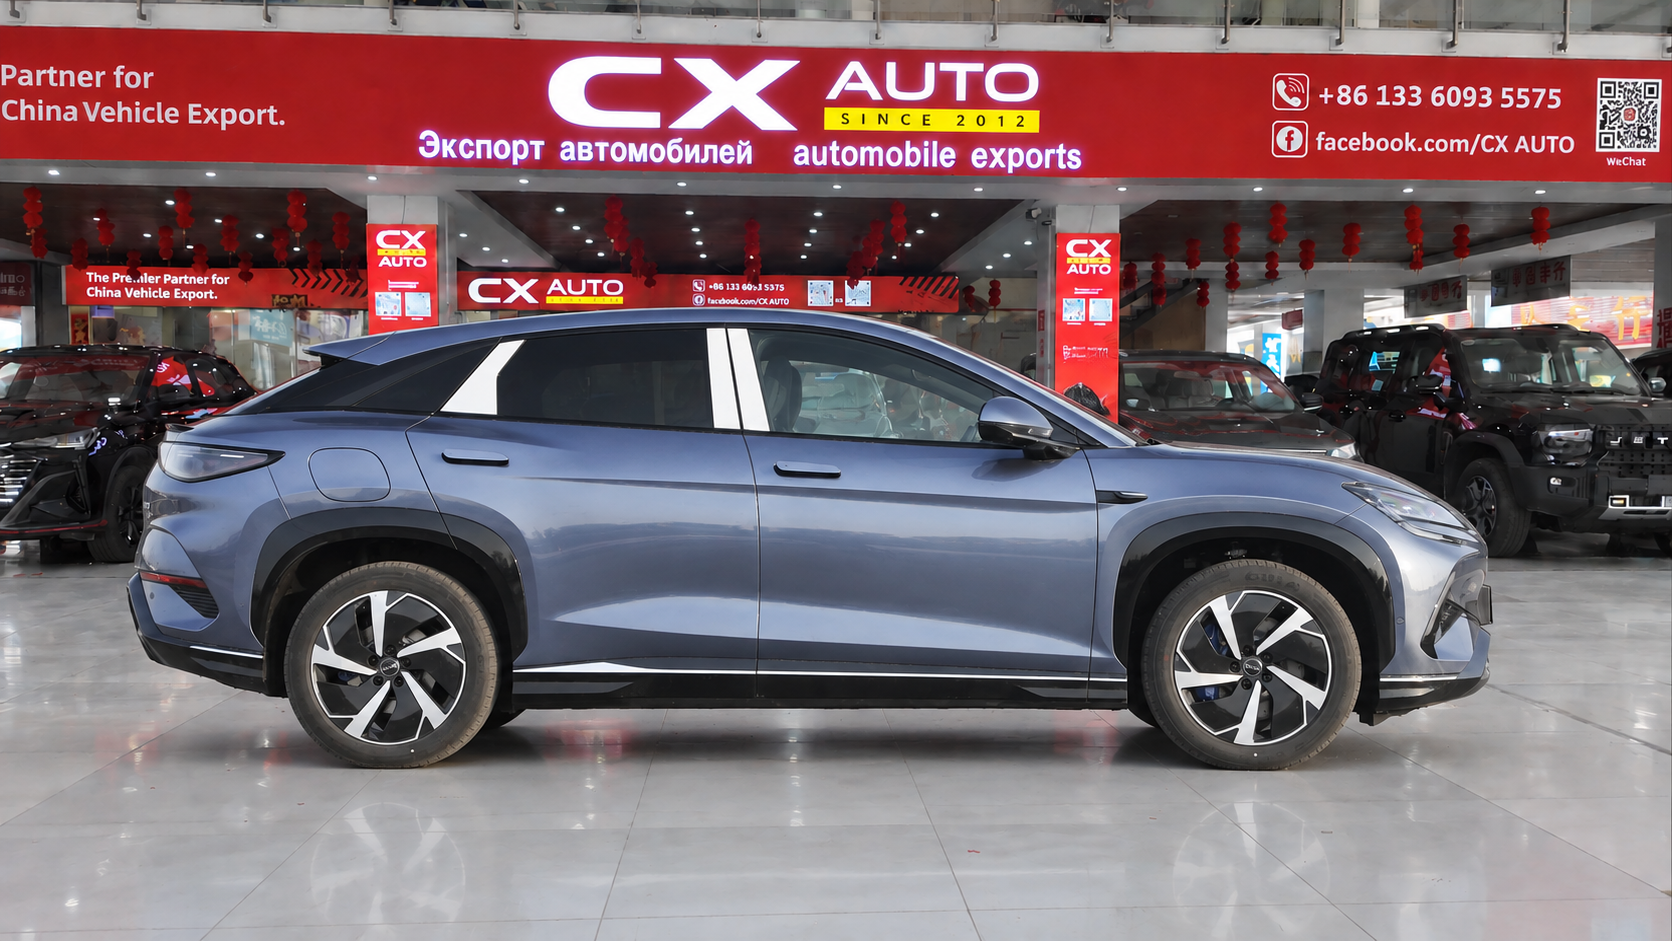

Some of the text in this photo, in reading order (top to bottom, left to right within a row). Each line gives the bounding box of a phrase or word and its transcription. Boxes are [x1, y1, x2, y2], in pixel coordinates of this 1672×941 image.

[1, 64, 154, 89] Partner for
[547, 55, 1039, 131] CX AUTO
[1318, 84, 1562, 109] +86 133 6093 5575
[1, 98, 285, 131] China Vehicle Export.
[841, 113, 1024, 127] SINCE 2012
[418, 130, 753, 165] Экспорт автомобилей
[1316, 131, 1575, 156] facebook.com/CX AUTO
[793, 140, 1082, 174] automobile exports
[1606, 156, 1646, 167] WeChat
[375, 230, 426, 249] CX
[1066, 239, 1112, 258] CX
[378, 256, 428, 268] AUTO
[1066, 264, 1112, 275] AUTO
[86, 272, 110, 283] The
[163, 273, 209, 285] Partner
[211, 273, 230, 285] for
[86, 286, 218, 302] China Vehicle Export.
[468, 278, 624, 303] CX AUTO
